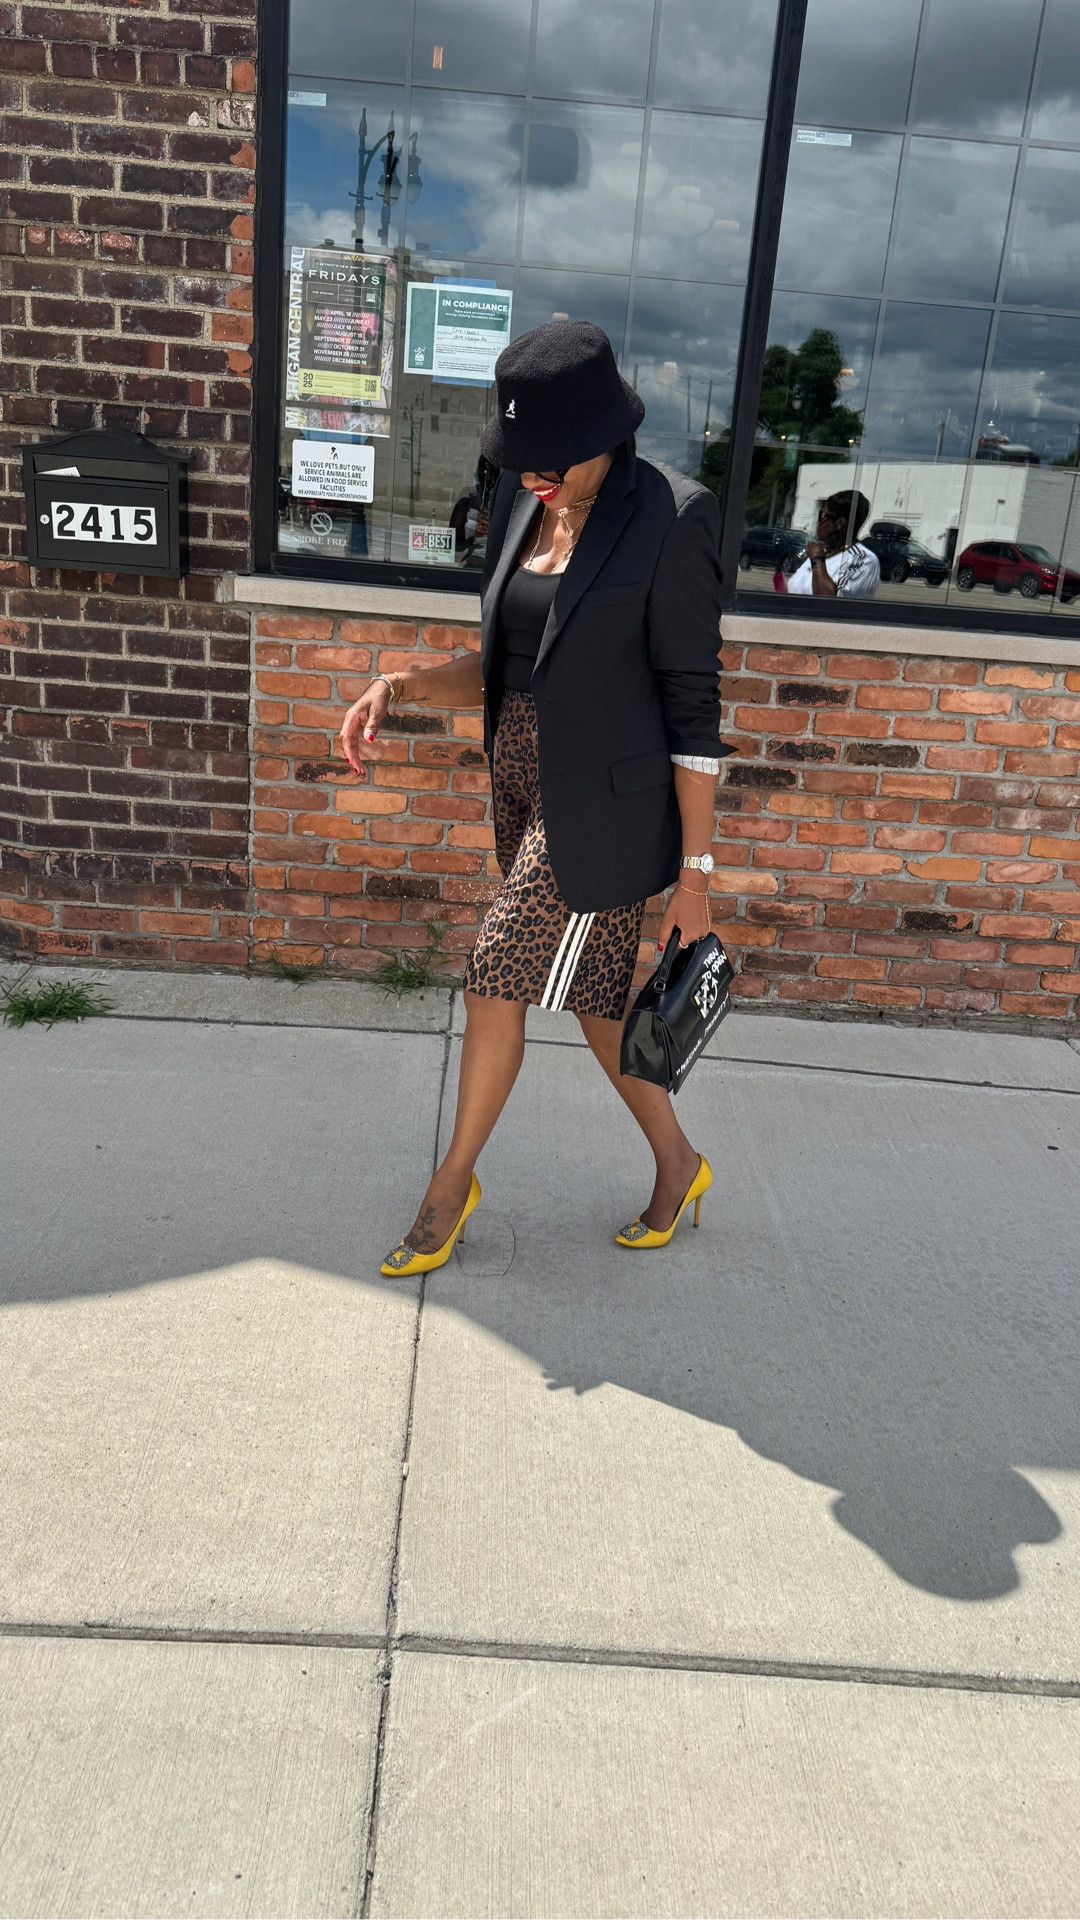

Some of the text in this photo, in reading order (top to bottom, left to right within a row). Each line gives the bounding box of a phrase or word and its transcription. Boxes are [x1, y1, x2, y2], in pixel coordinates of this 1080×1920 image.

[308, 269, 380, 285] FRIDAYS
[289, 248, 305, 333] CENTRAL
[442, 299, 508, 312] IN COMPLIANCE
[313, 335, 345, 343] SEPTEMBER
[332, 357, 361, 365] DECEMBER
[303, 372, 314, 381] 20
[303, 380, 313, 388] 25
[304, 468, 362, 479] SERVICE ANIMALS ARE
[298, 475, 368, 487] ALLOWED IN FOOD SERVICE
[319, 484, 346, 492] FACILITIES
[336, 492, 368, 500] UNDERSTANDING
[55, 504, 153, 541] 2415
[291, 534, 324, 545] SMOKE
[413, 536, 424, 548] 4
[428, 534, 451, 549] BEST
[702, 947, 719, 968] TURN
[701, 949, 727, 983] TO OPEN
